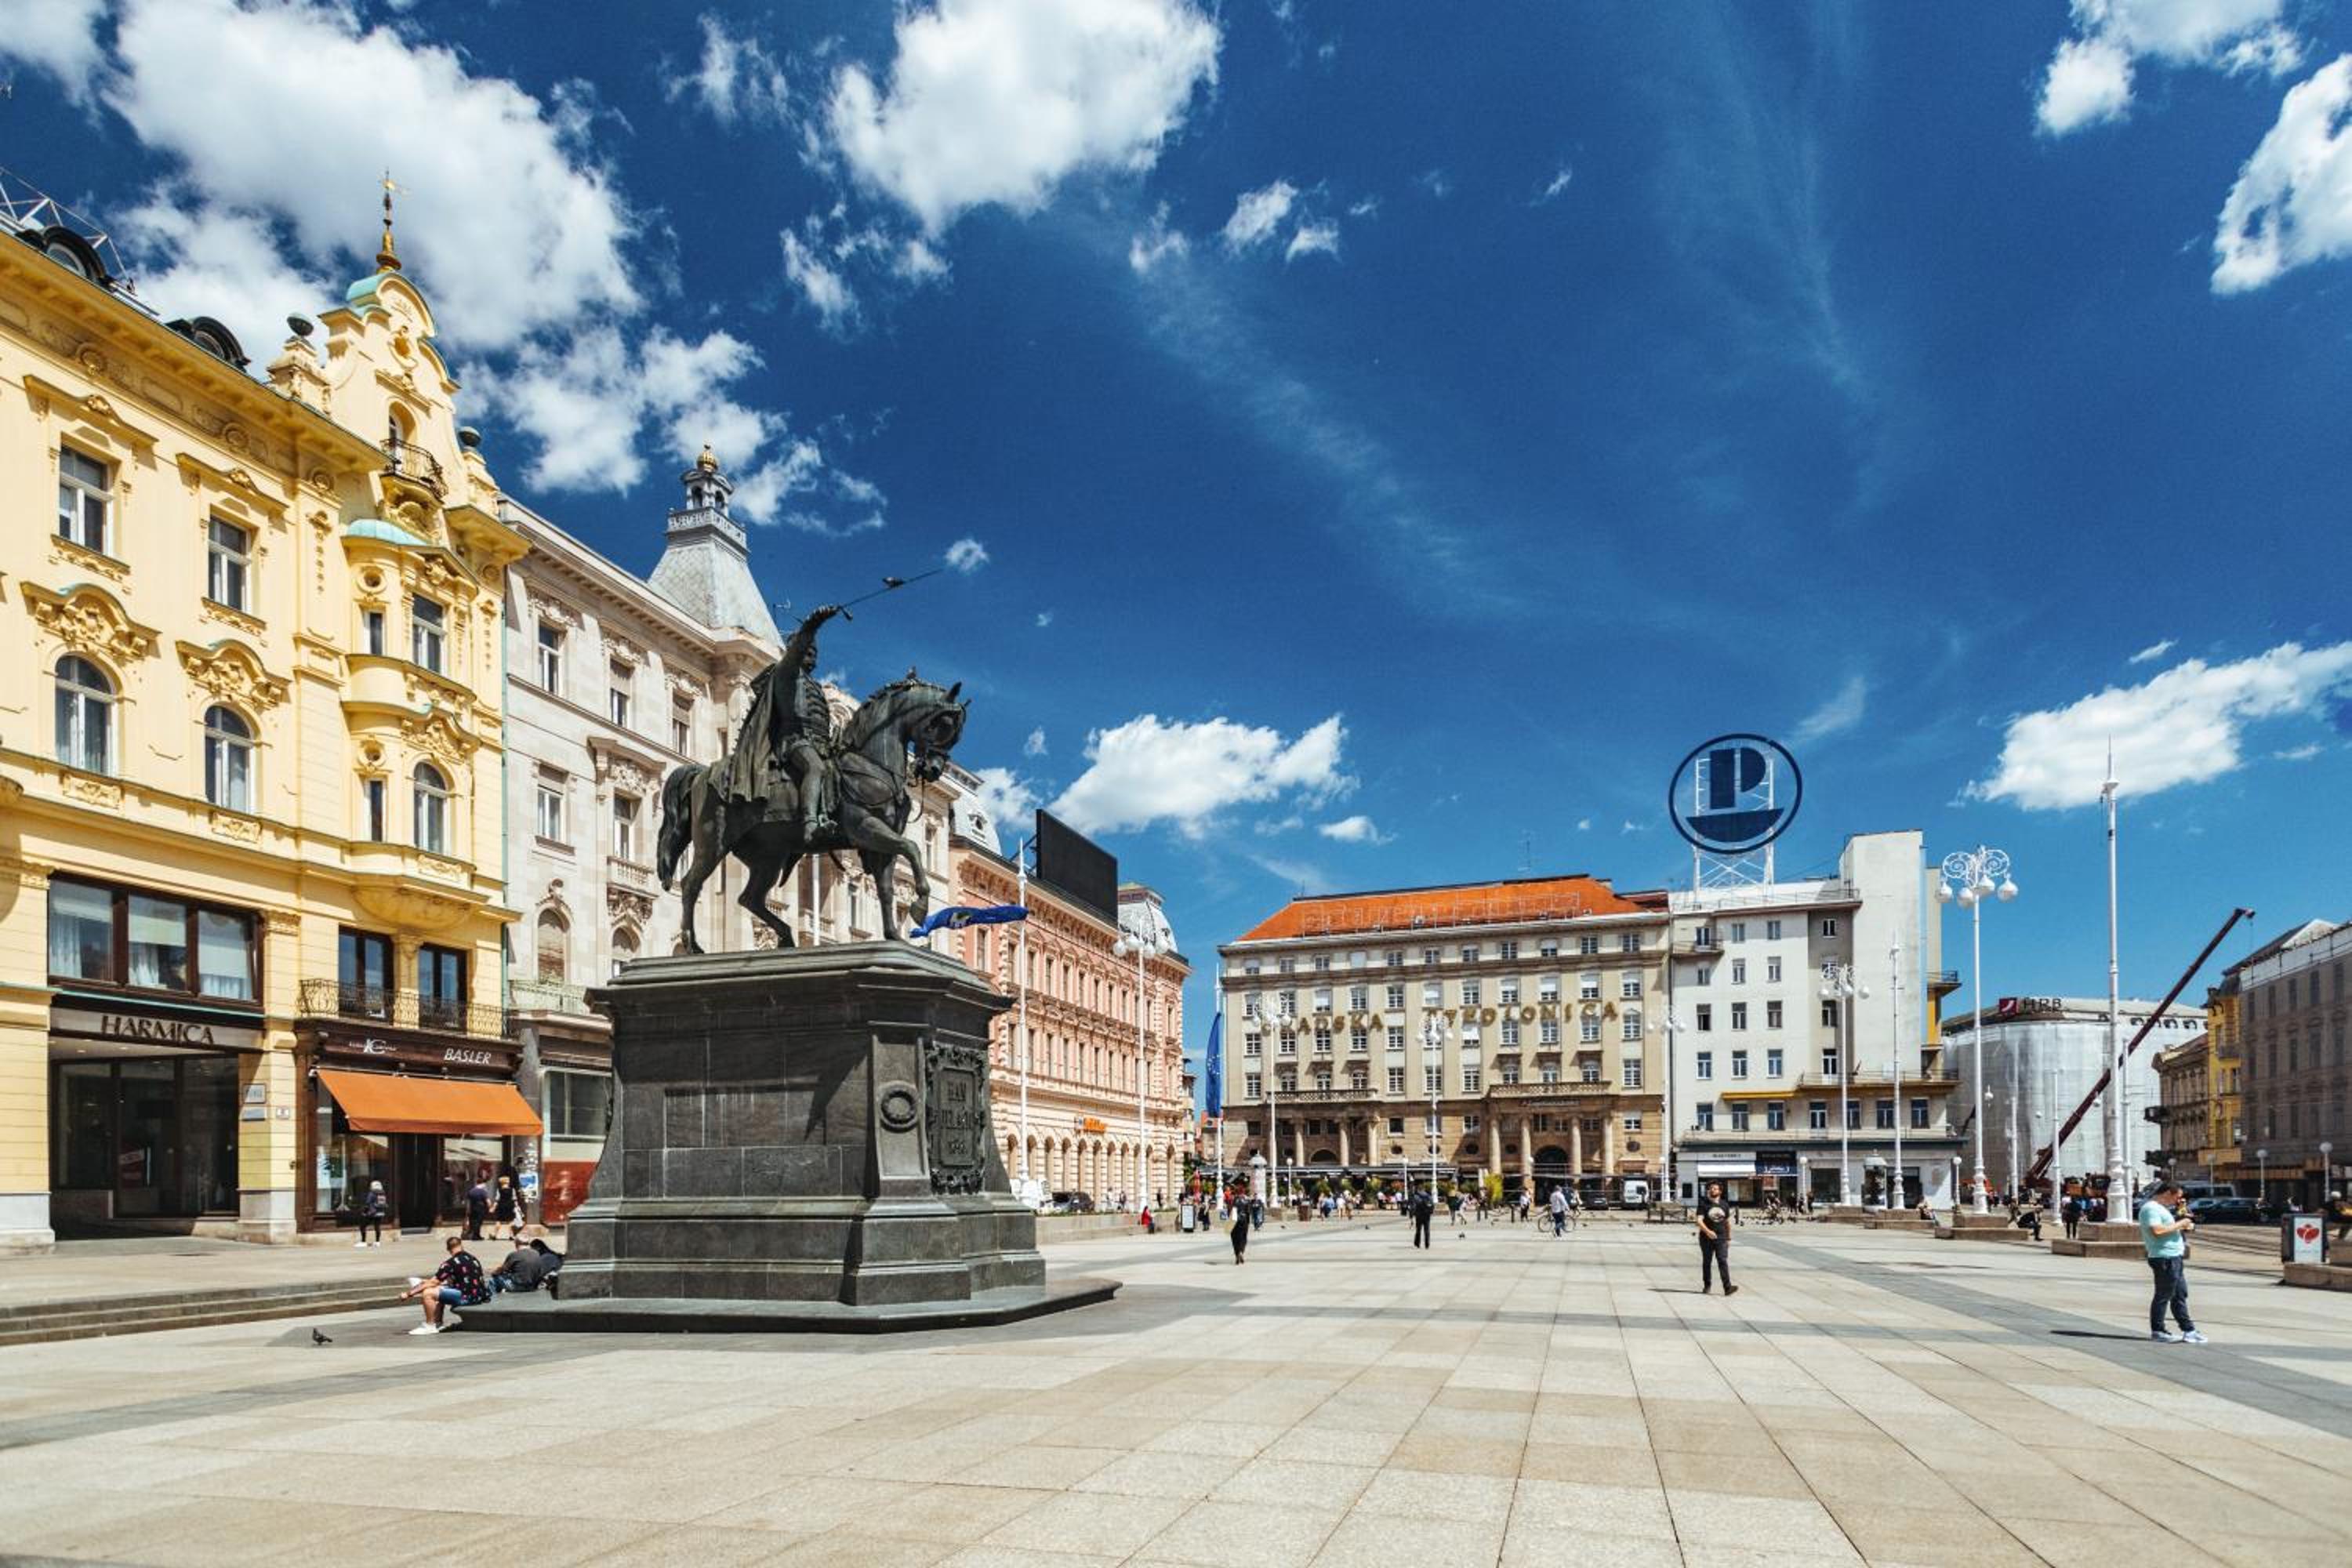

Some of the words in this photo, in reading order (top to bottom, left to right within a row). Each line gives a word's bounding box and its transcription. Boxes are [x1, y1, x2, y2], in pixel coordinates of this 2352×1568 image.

[100, 1014, 214, 1044] HARMICA
[1428, 1001, 1618, 1029] TEDIONICA
[444, 1047, 491, 1065] BASLER
